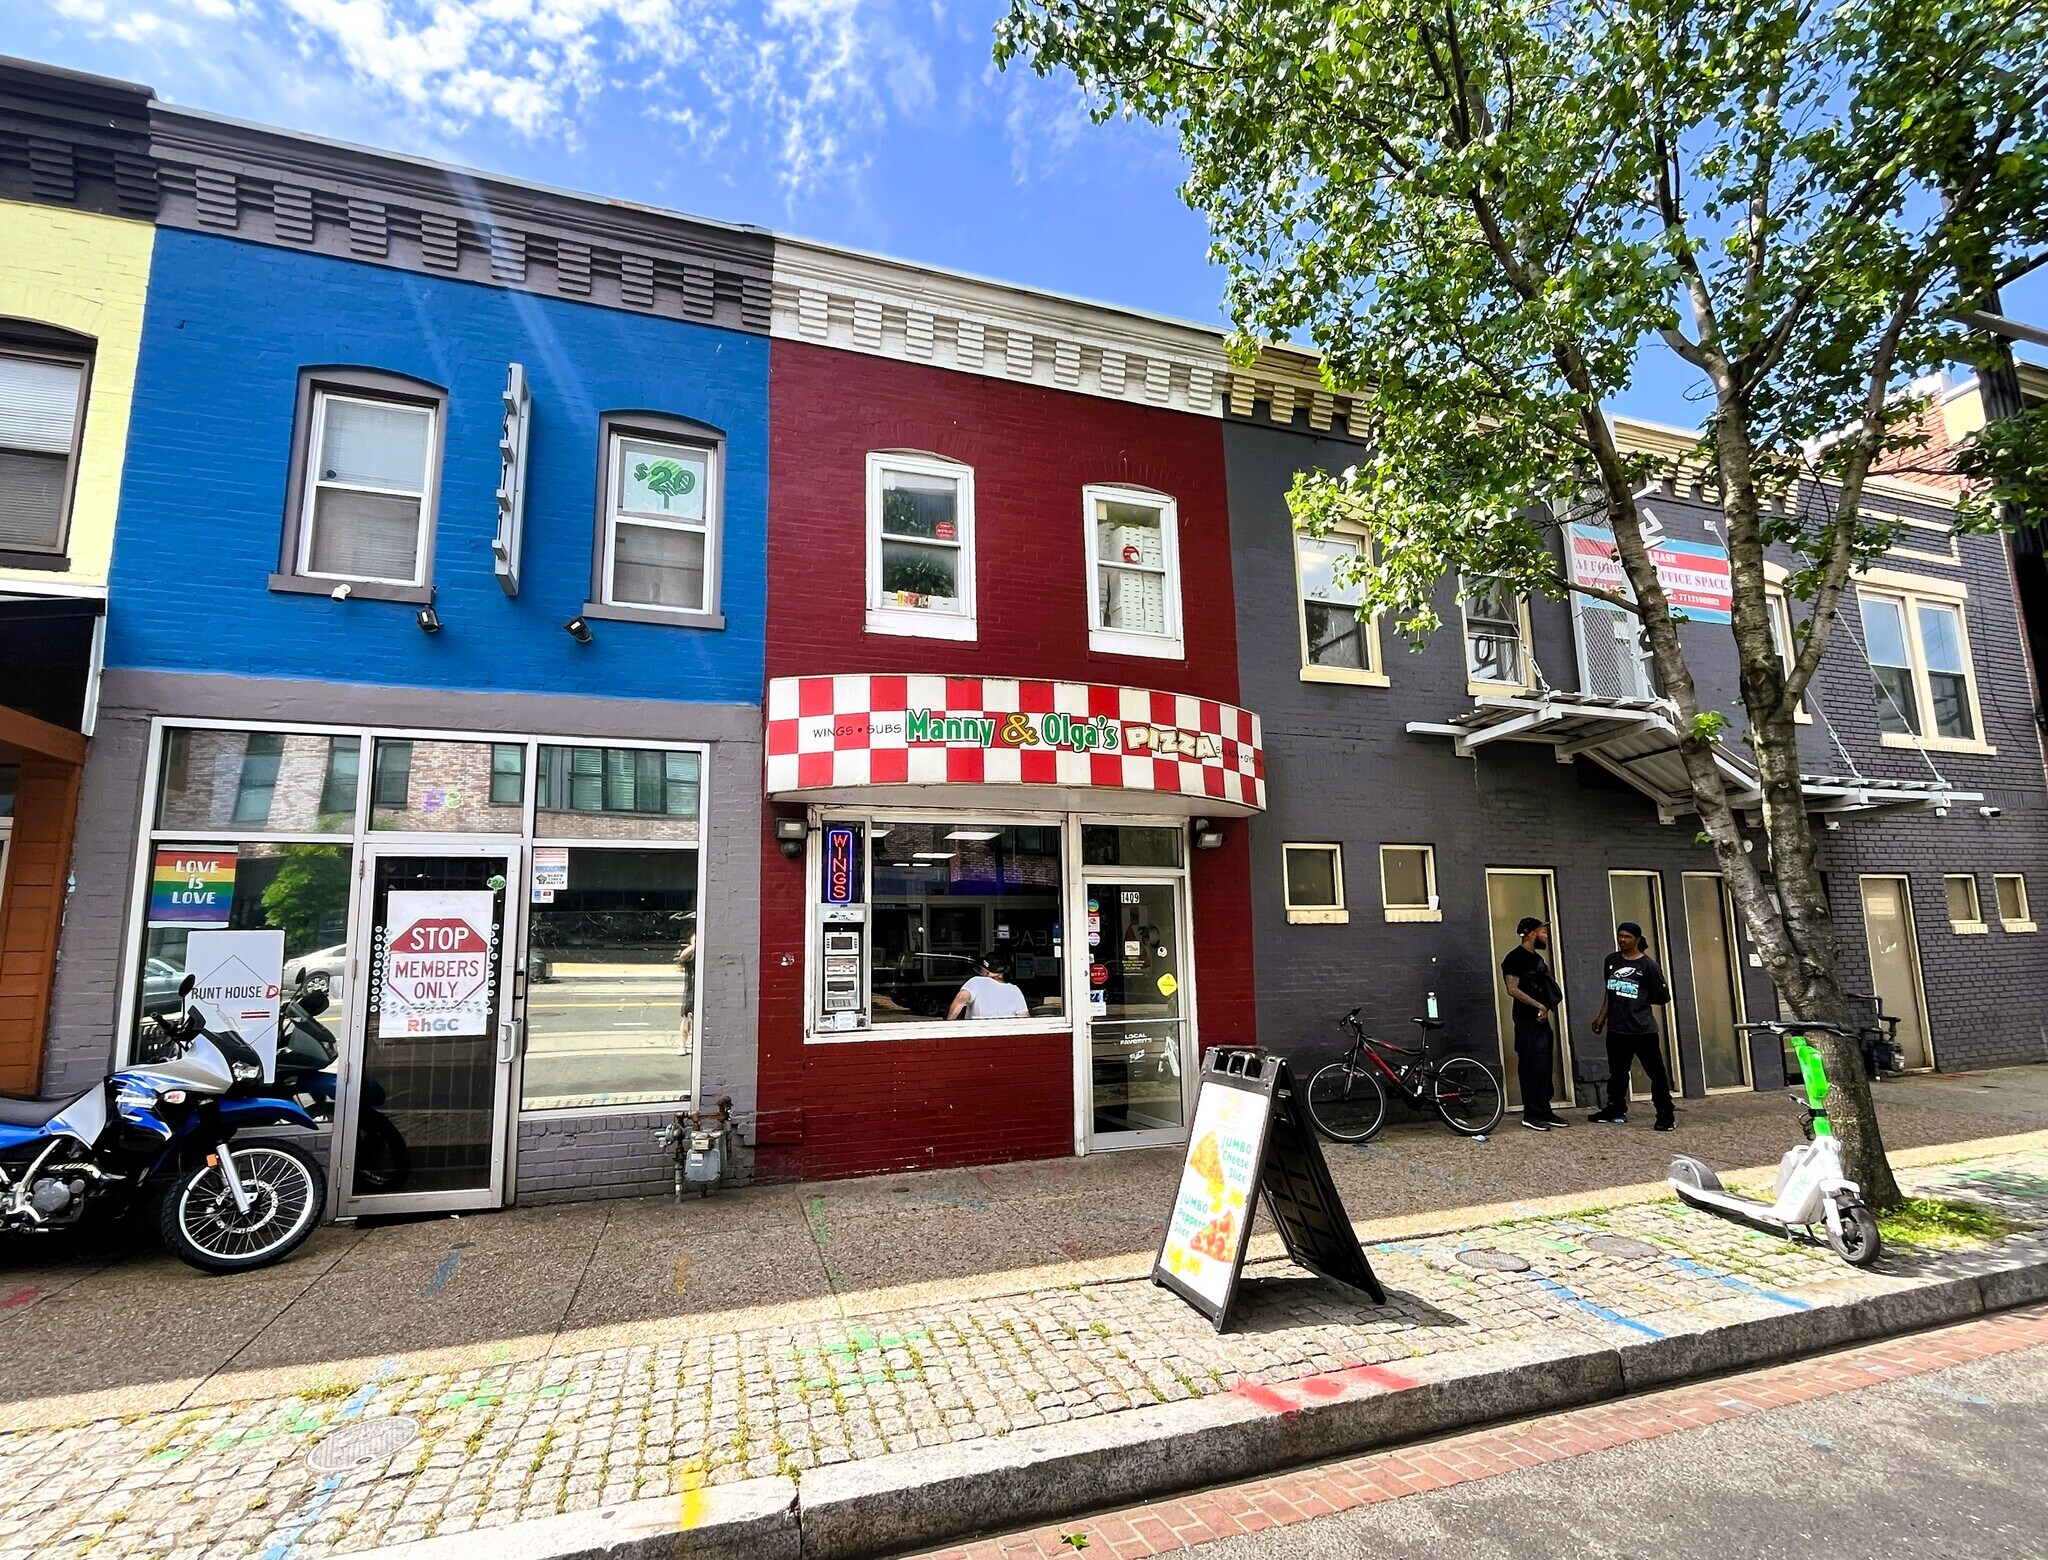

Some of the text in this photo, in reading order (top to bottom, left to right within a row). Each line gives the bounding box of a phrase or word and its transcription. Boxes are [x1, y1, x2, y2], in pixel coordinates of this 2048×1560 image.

[1661, 570, 1728, 590] FFICE SPACE
[813, 723, 902, 738] WINGS SUBS
[905, 708, 1218, 759] Manny & Olga's PIZZA
[175, 860, 219, 874] LOVE
[832, 834, 848, 899] WINGS
[188, 874, 205, 889] is
[172, 891, 217, 905] LOVE
[1122, 892, 1140, 903] 1409
[410, 927, 470, 951] STOP
[395, 960, 479, 979] MEMBERS
[225, 985, 262, 999] HOUSE
[413, 980, 459, 999] ONLY
[407, 1017, 460, 1033] RhGC
[1124, 1032, 1148, 1040] LOCAL
[1221, 1136, 1252, 1155] JUMBO
[1222, 1150, 1250, 1170] Cheese
[1229, 1166, 1247, 1184] Slice
[1180, 1192, 1209, 1214] JUMBO
[1173, 1221, 1190, 1240] Slice
